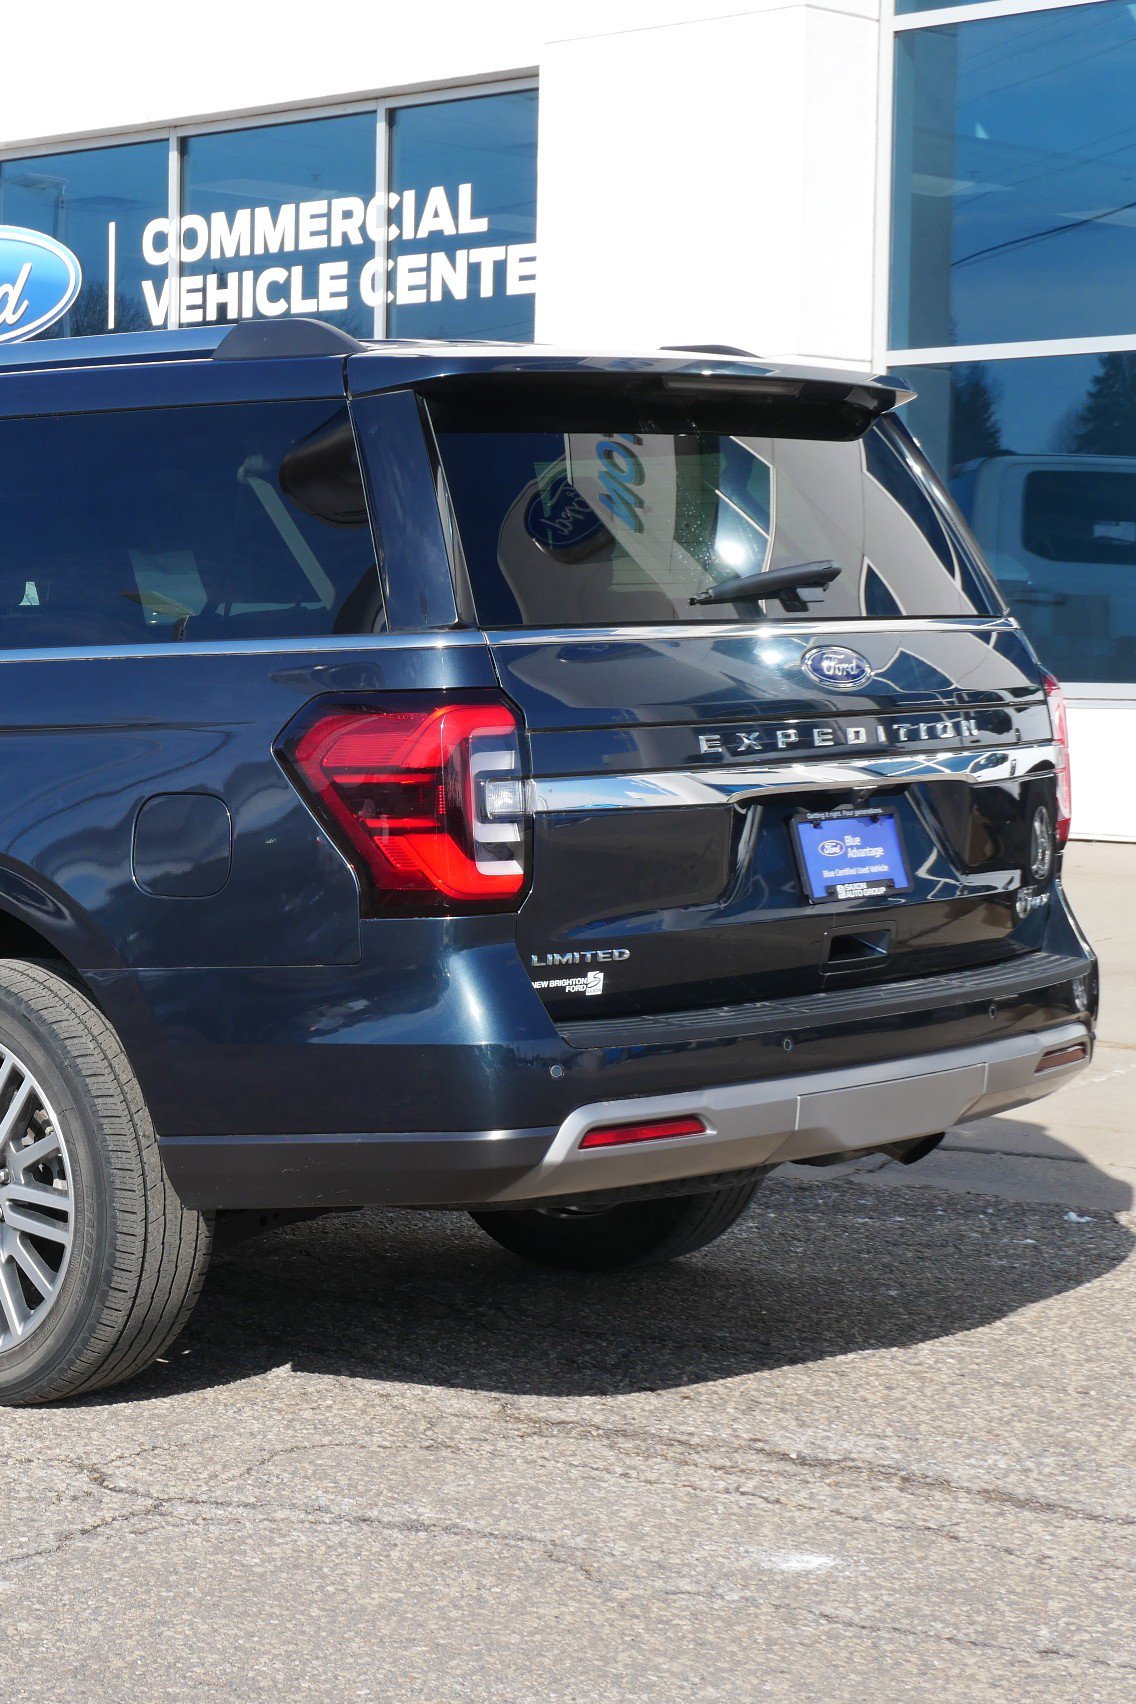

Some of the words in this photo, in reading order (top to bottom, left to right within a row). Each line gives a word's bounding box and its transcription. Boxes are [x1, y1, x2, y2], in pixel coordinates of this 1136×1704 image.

[142, 183, 489, 266] COMMERCIAL
[141, 261, 349, 326] VEHICLE
[821, 654, 861, 676] Ford
[698, 719, 979, 755] EXPEDITION
[844, 835, 861, 846] Blue
[823, 842, 841, 854] Ford
[847, 847, 884, 858] Advantage
[845, 882, 868, 891] SAXON
[845, 889, 863, 898] AUTO
[863, 886, 887, 897] GROUP
[531, 948, 631, 967] LIMITED
[531, 980, 549, 989] NEW
[549, 977, 588, 988] BRIGHTON
[565, 984, 587, 993] FORD
